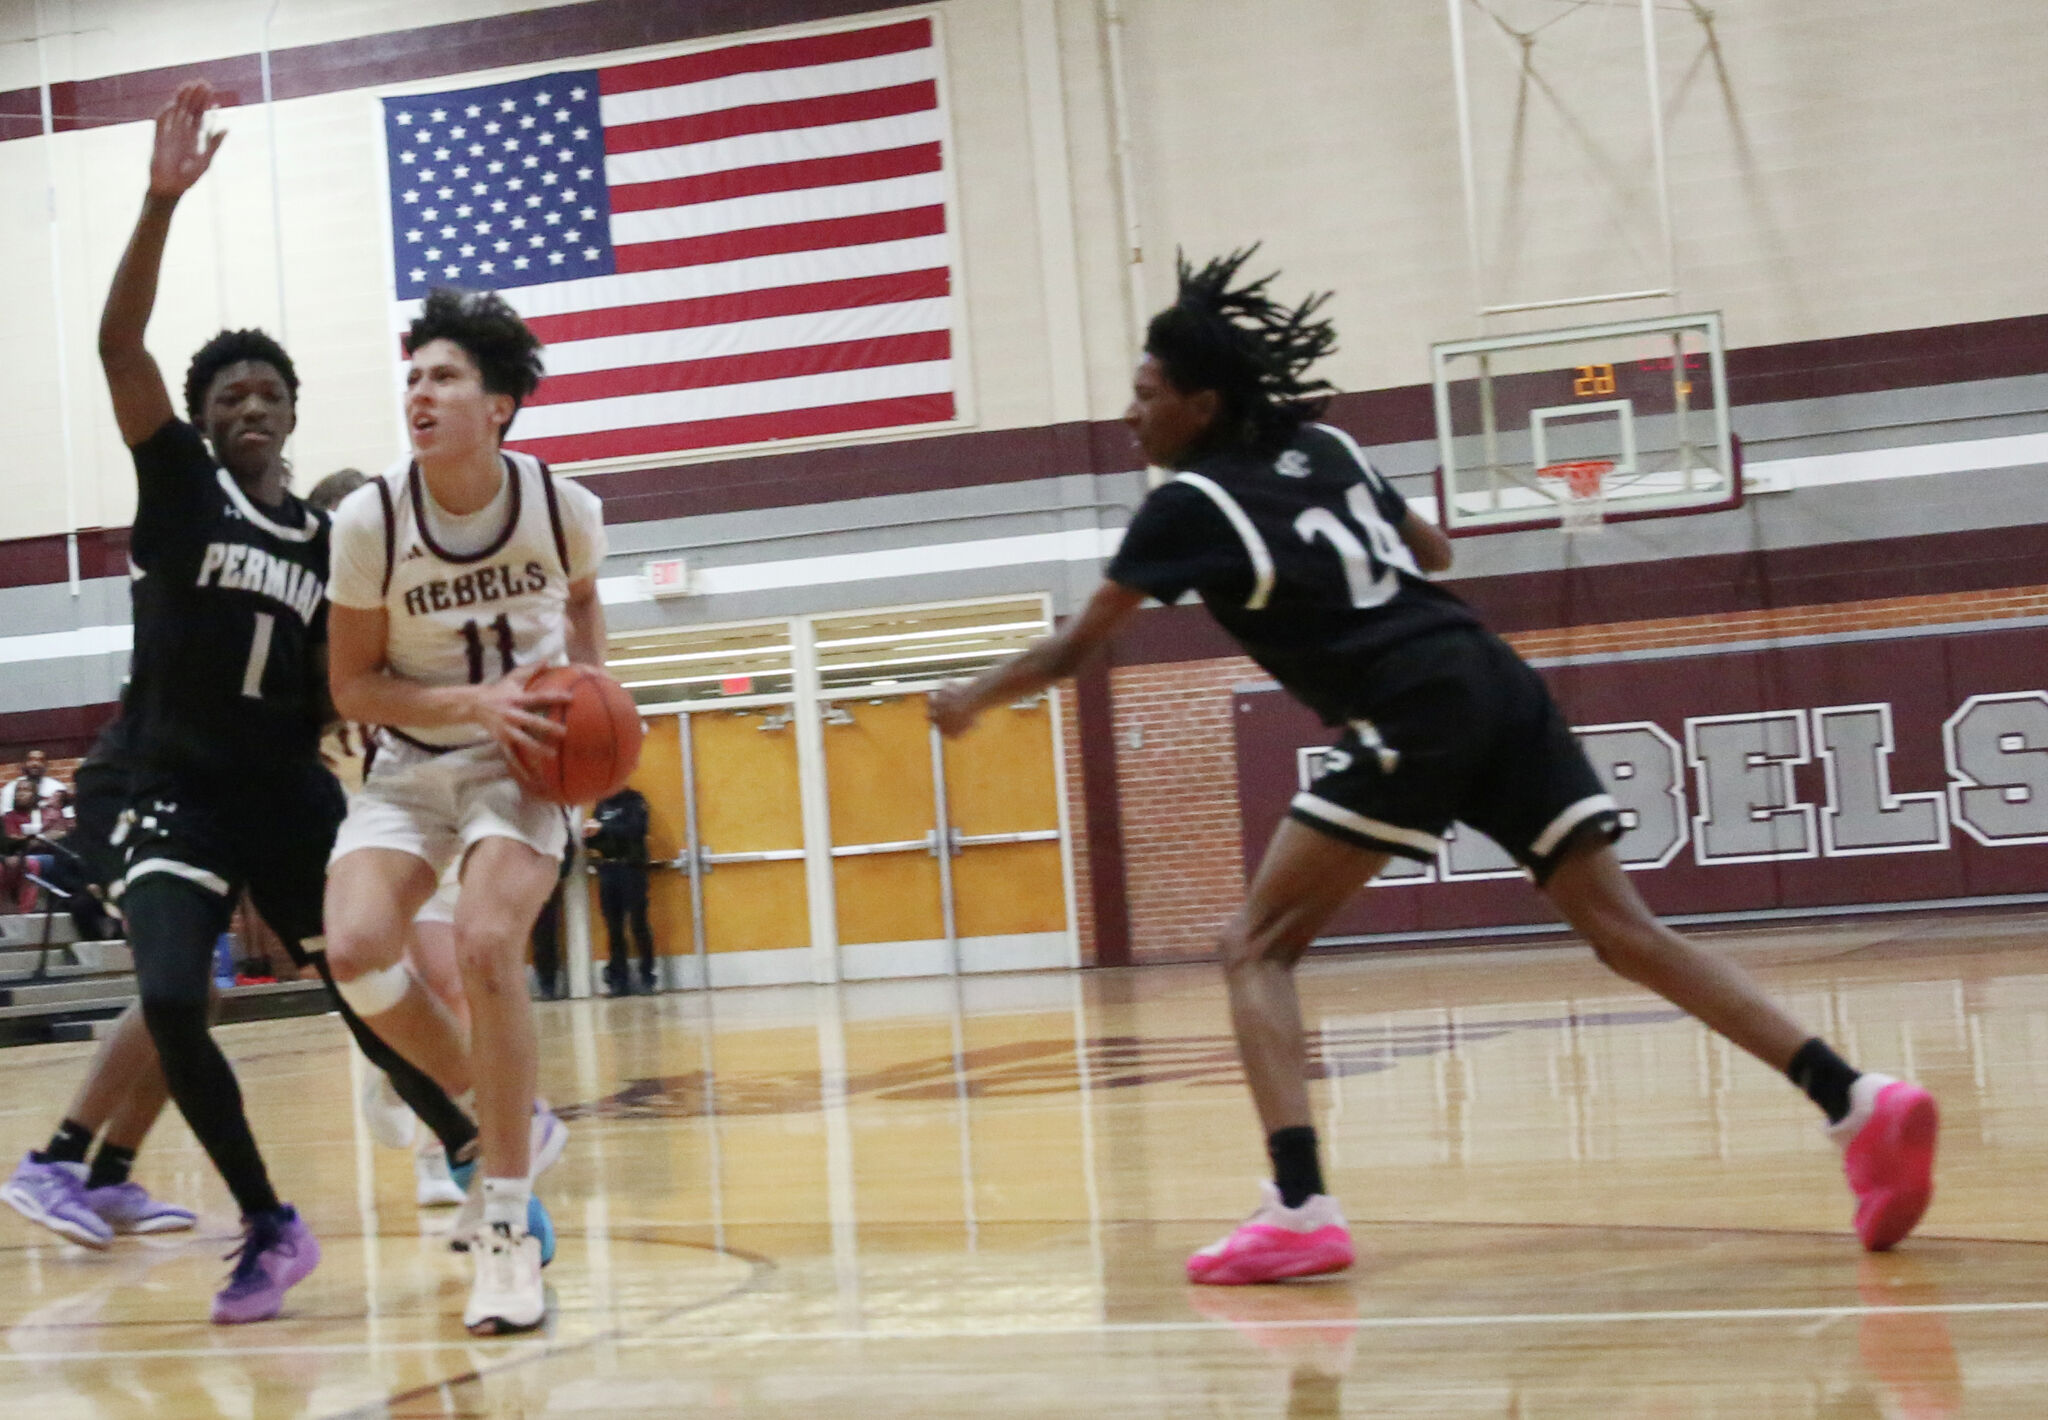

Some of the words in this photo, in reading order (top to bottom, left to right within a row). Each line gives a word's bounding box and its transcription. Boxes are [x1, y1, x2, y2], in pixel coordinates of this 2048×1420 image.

[404, 560, 547, 616] REBELS
[241, 611, 276, 699] 1
[457, 612, 518, 685] 11
[1297, 690, 2048, 887] BELS
